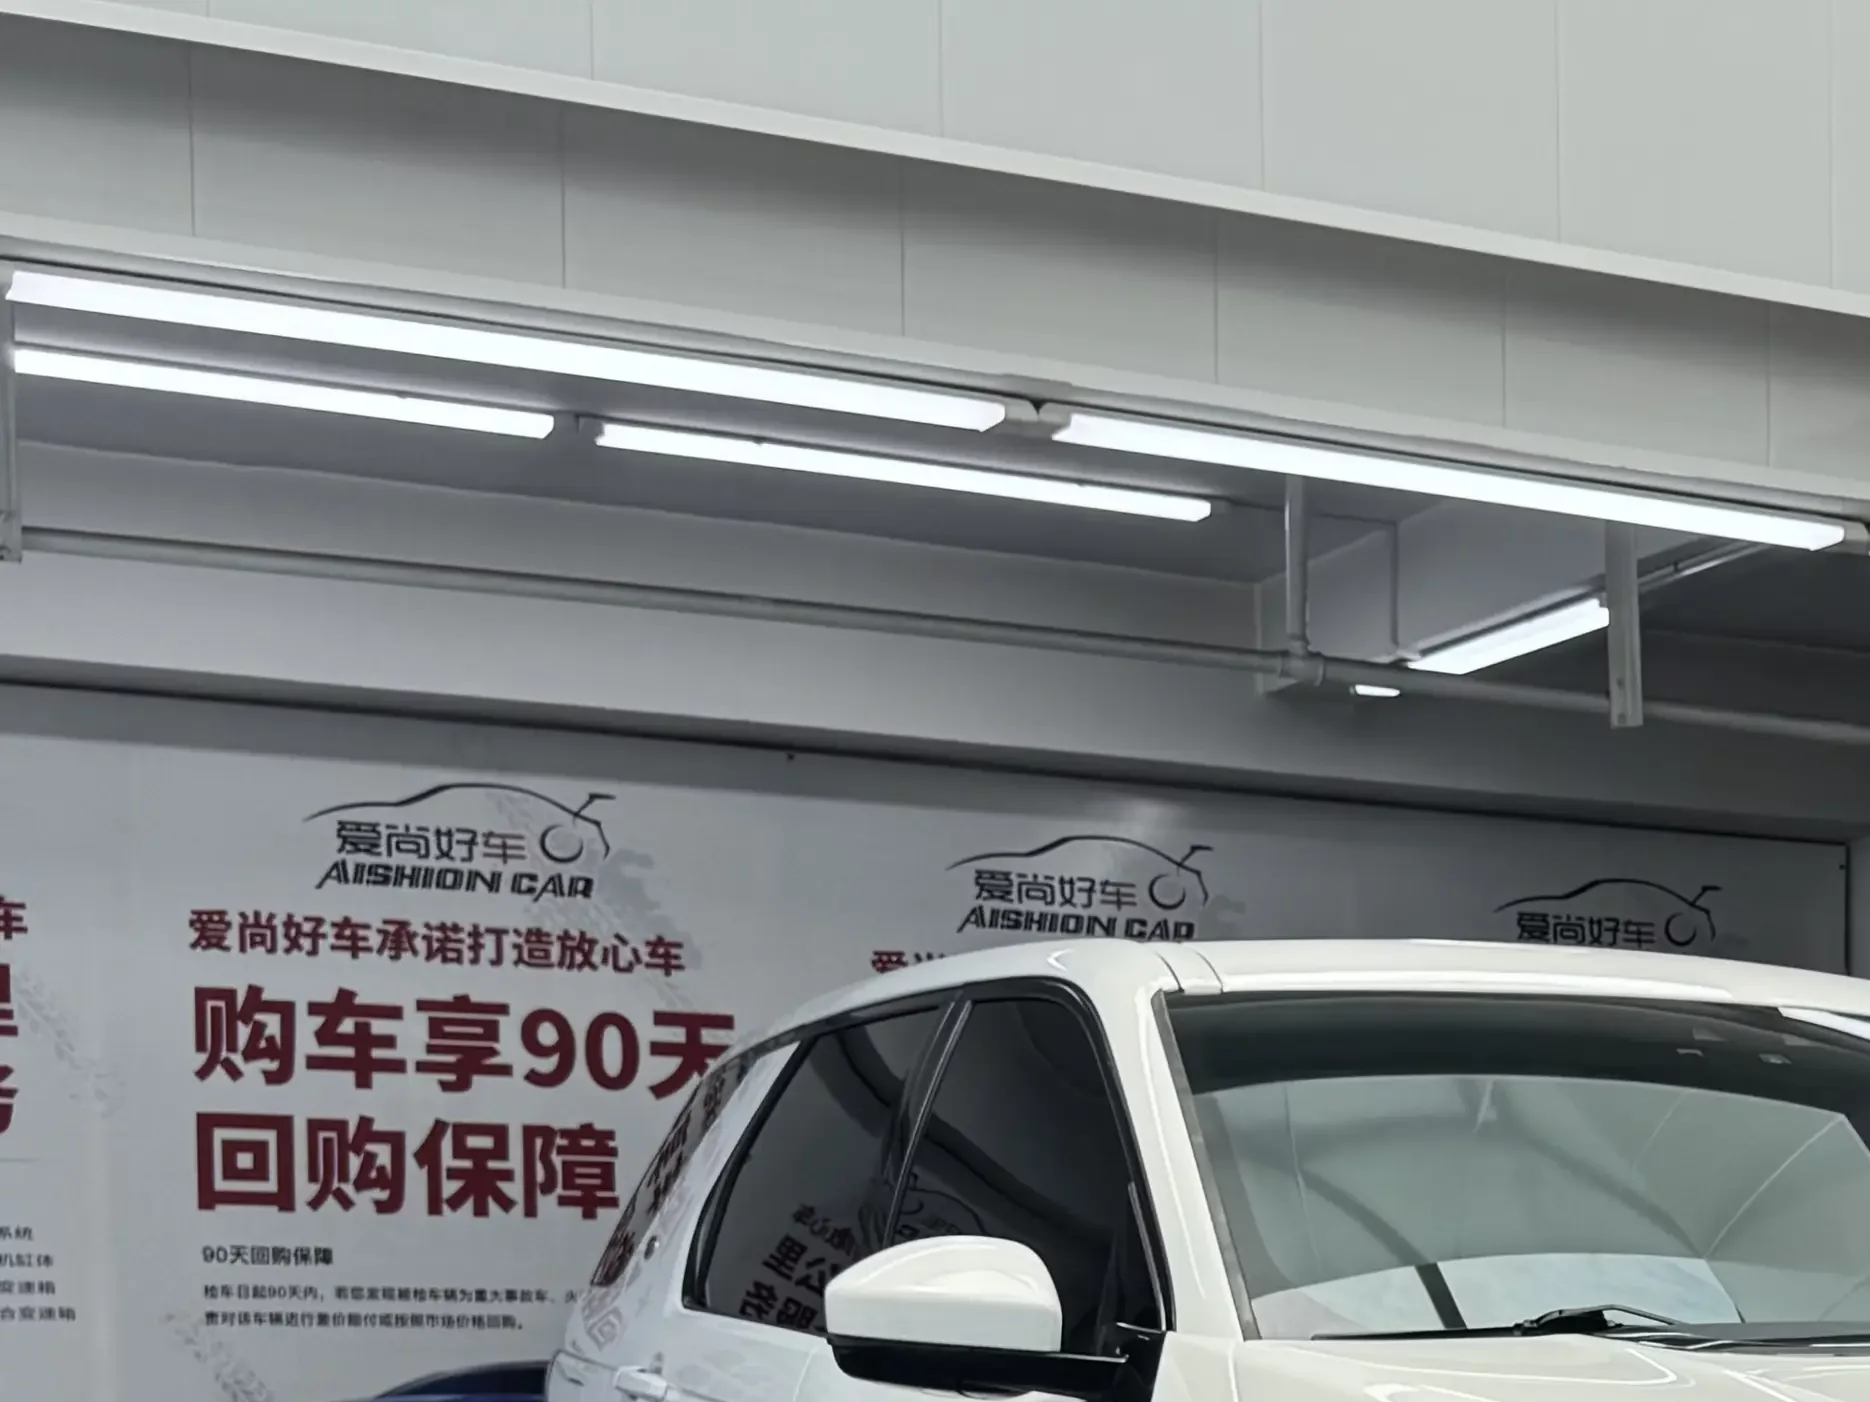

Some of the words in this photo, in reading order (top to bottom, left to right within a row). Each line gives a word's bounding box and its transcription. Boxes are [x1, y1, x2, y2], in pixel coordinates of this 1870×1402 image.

[336, 820, 527, 864] 爱尚好车
[315, 858, 502, 893] AISHION
[511, 872, 594, 902] CAR
[974, 869, 1138, 911] 爱尚好车
[957, 904, 1118, 937] AISHION
[1516, 911, 1656, 949] 爱尚好车
[188, 909, 686, 977] 爱尚好车承诺打造放心车
[194, 984, 735, 1099] 购车享90天
[195, 1111, 620, 1219] 回购保障
[202, 1245, 334, 1265] 90天回购保障
